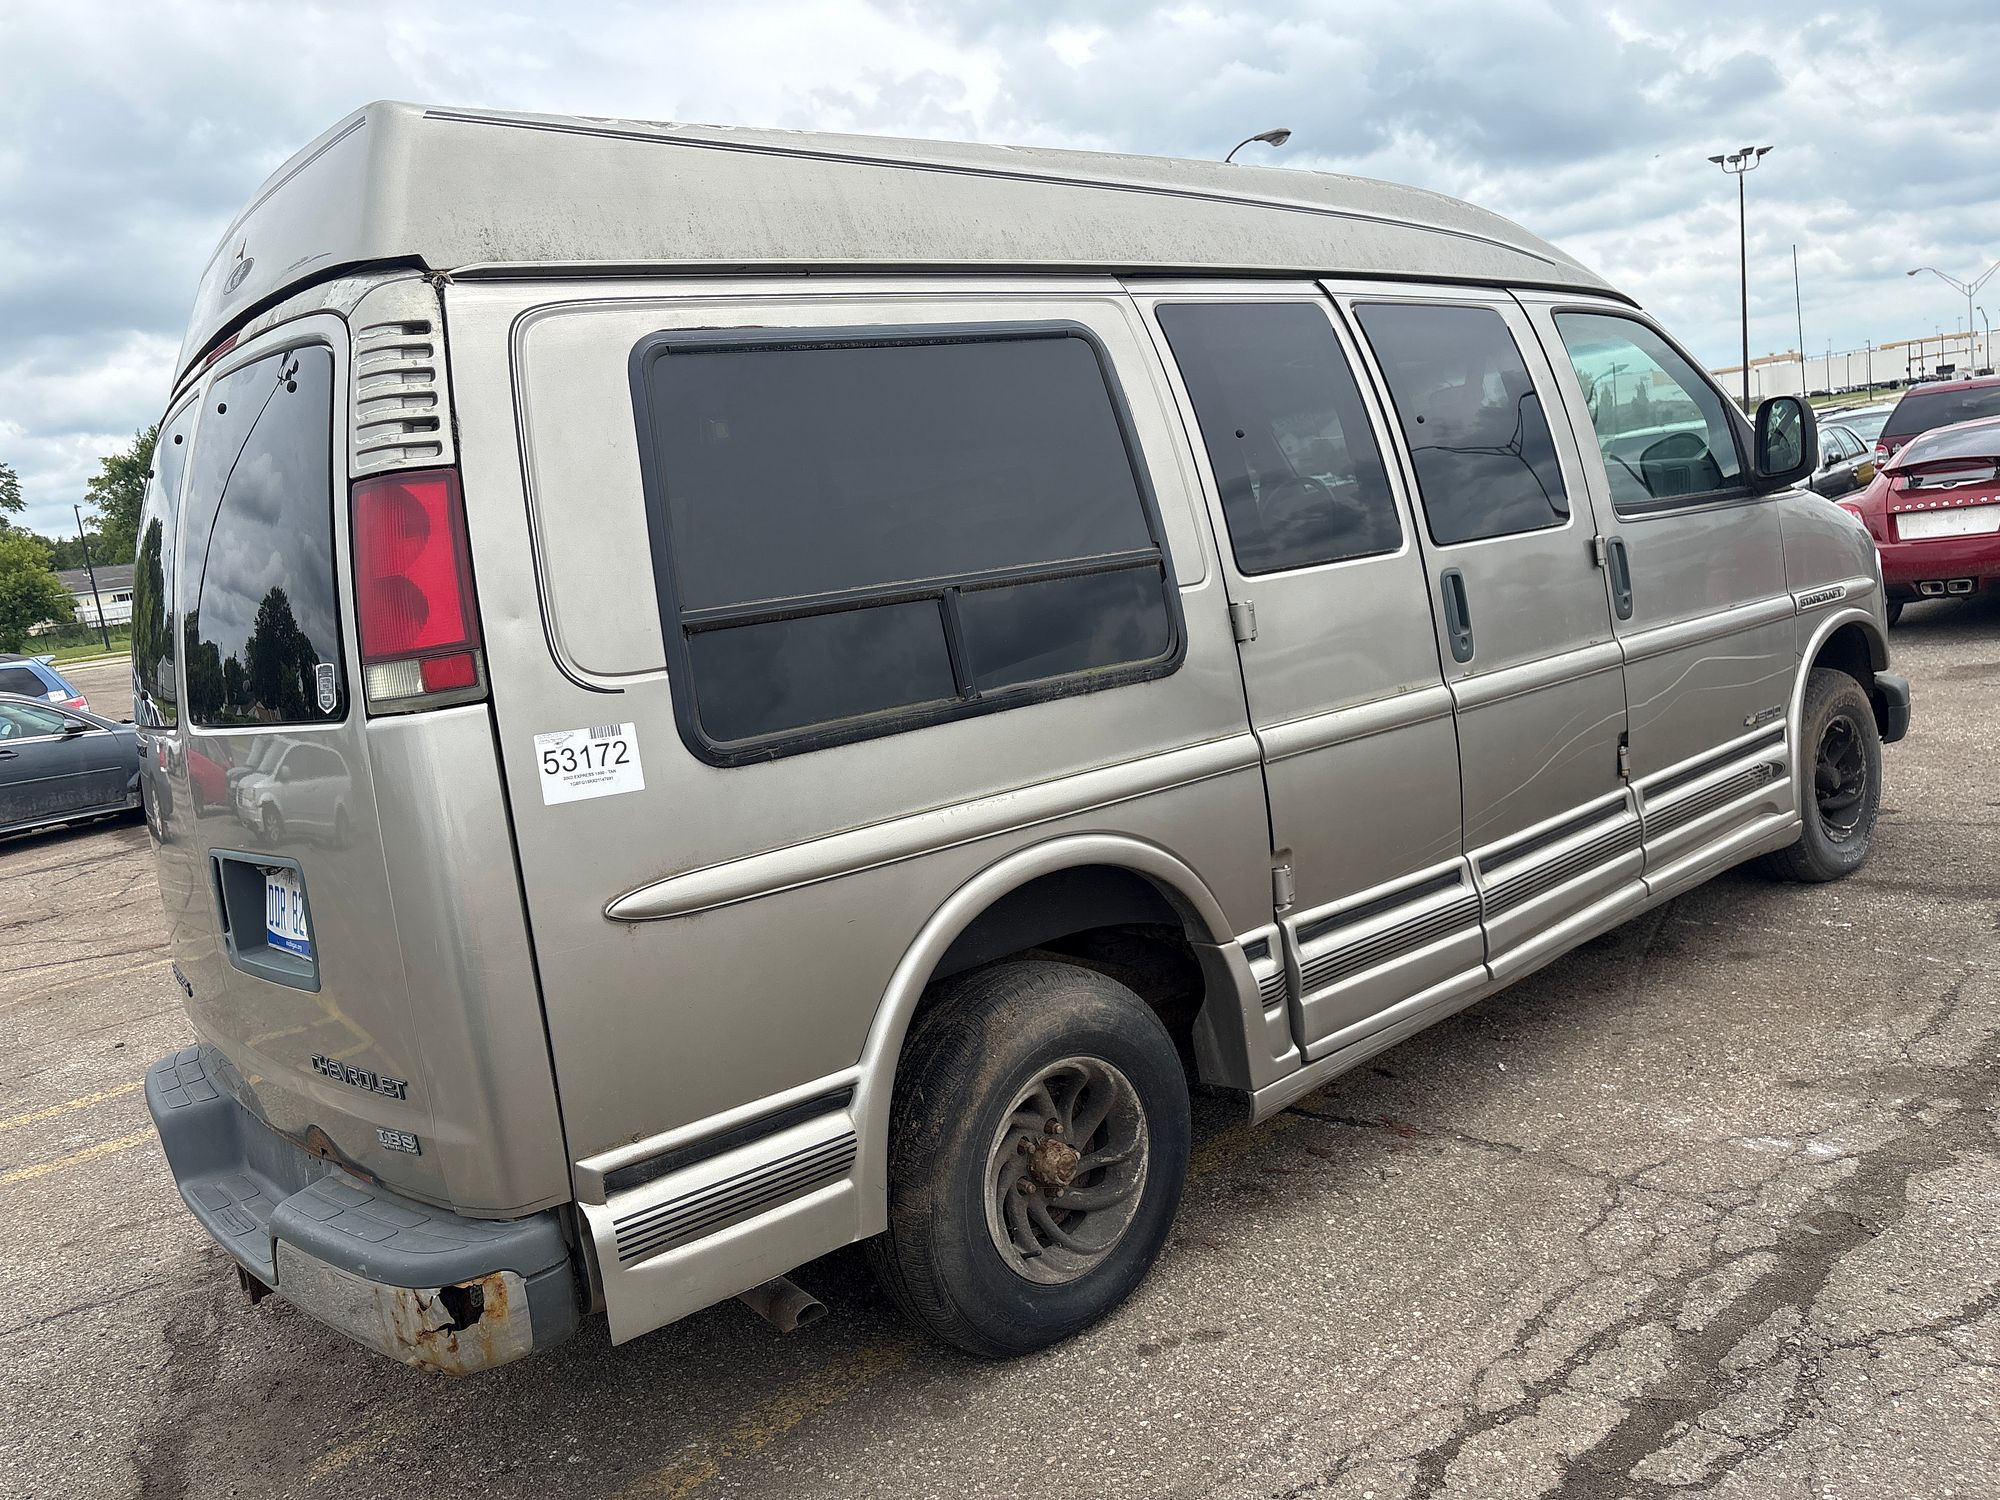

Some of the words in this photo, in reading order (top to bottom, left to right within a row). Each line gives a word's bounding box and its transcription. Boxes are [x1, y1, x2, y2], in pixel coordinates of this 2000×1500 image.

[1799, 589, 1842, 608] STARCRAFT
[543, 740, 630, 775] 53172
[292, 890, 308, 937] 82
[310, 1052, 408, 1101] CHEVROLET
